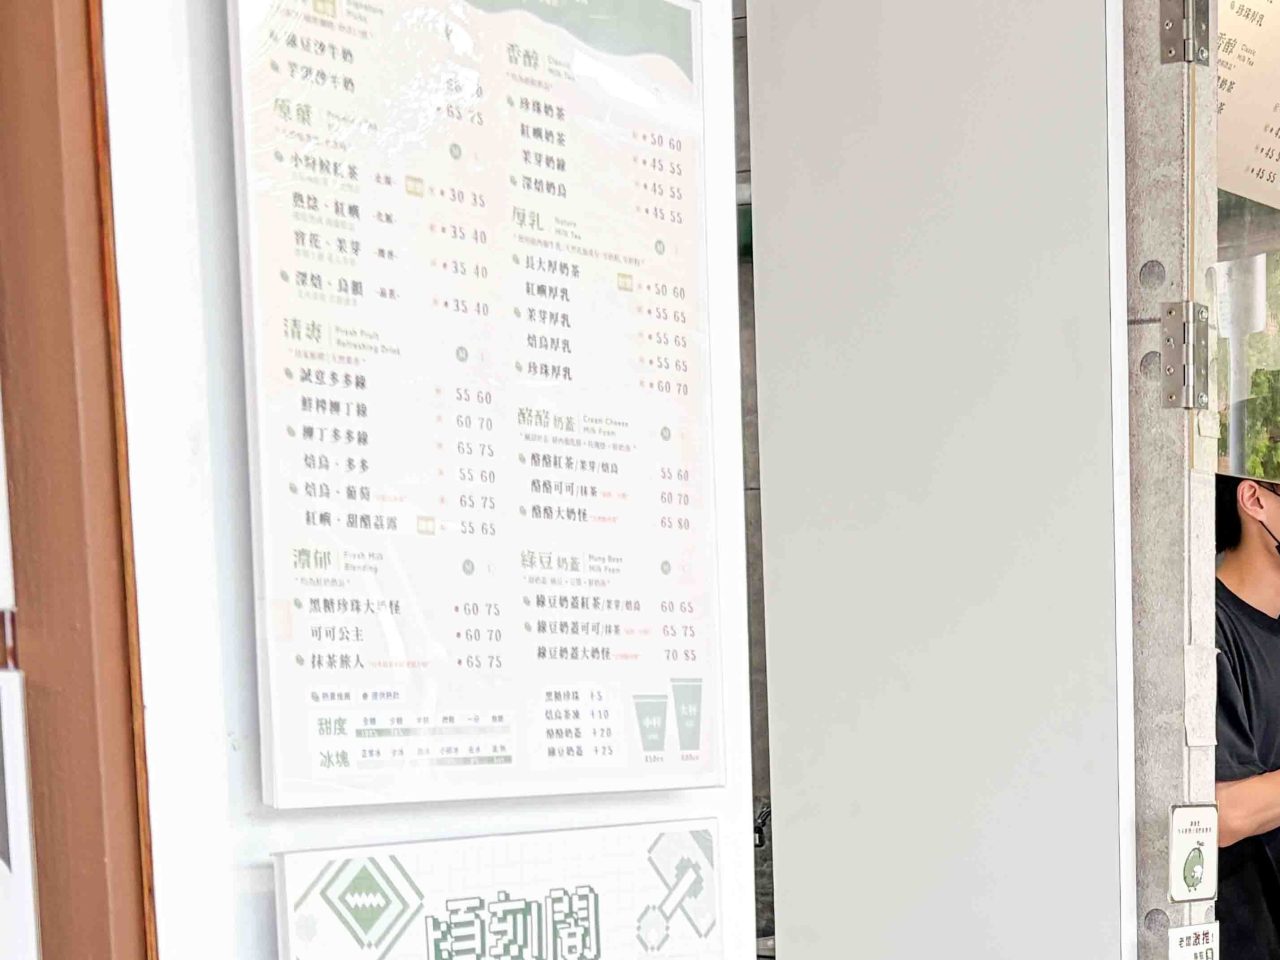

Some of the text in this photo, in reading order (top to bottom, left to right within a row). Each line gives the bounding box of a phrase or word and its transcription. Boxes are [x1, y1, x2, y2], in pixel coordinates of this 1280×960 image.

[464, 602, 479, 616] 60
[485, 603, 500, 617] 75
[661, 600, 694, 614] 60 65
[310, 626, 502, 642] 可可公主 60 70
[663, 625, 676, 638] 65
[682, 626, 696, 638] 75
[466, 655, 482, 669] 65
[488, 656, 502, 669] 75
[318, 716, 348, 736] 甜度
[320, 750, 350, 769] 冰塊
